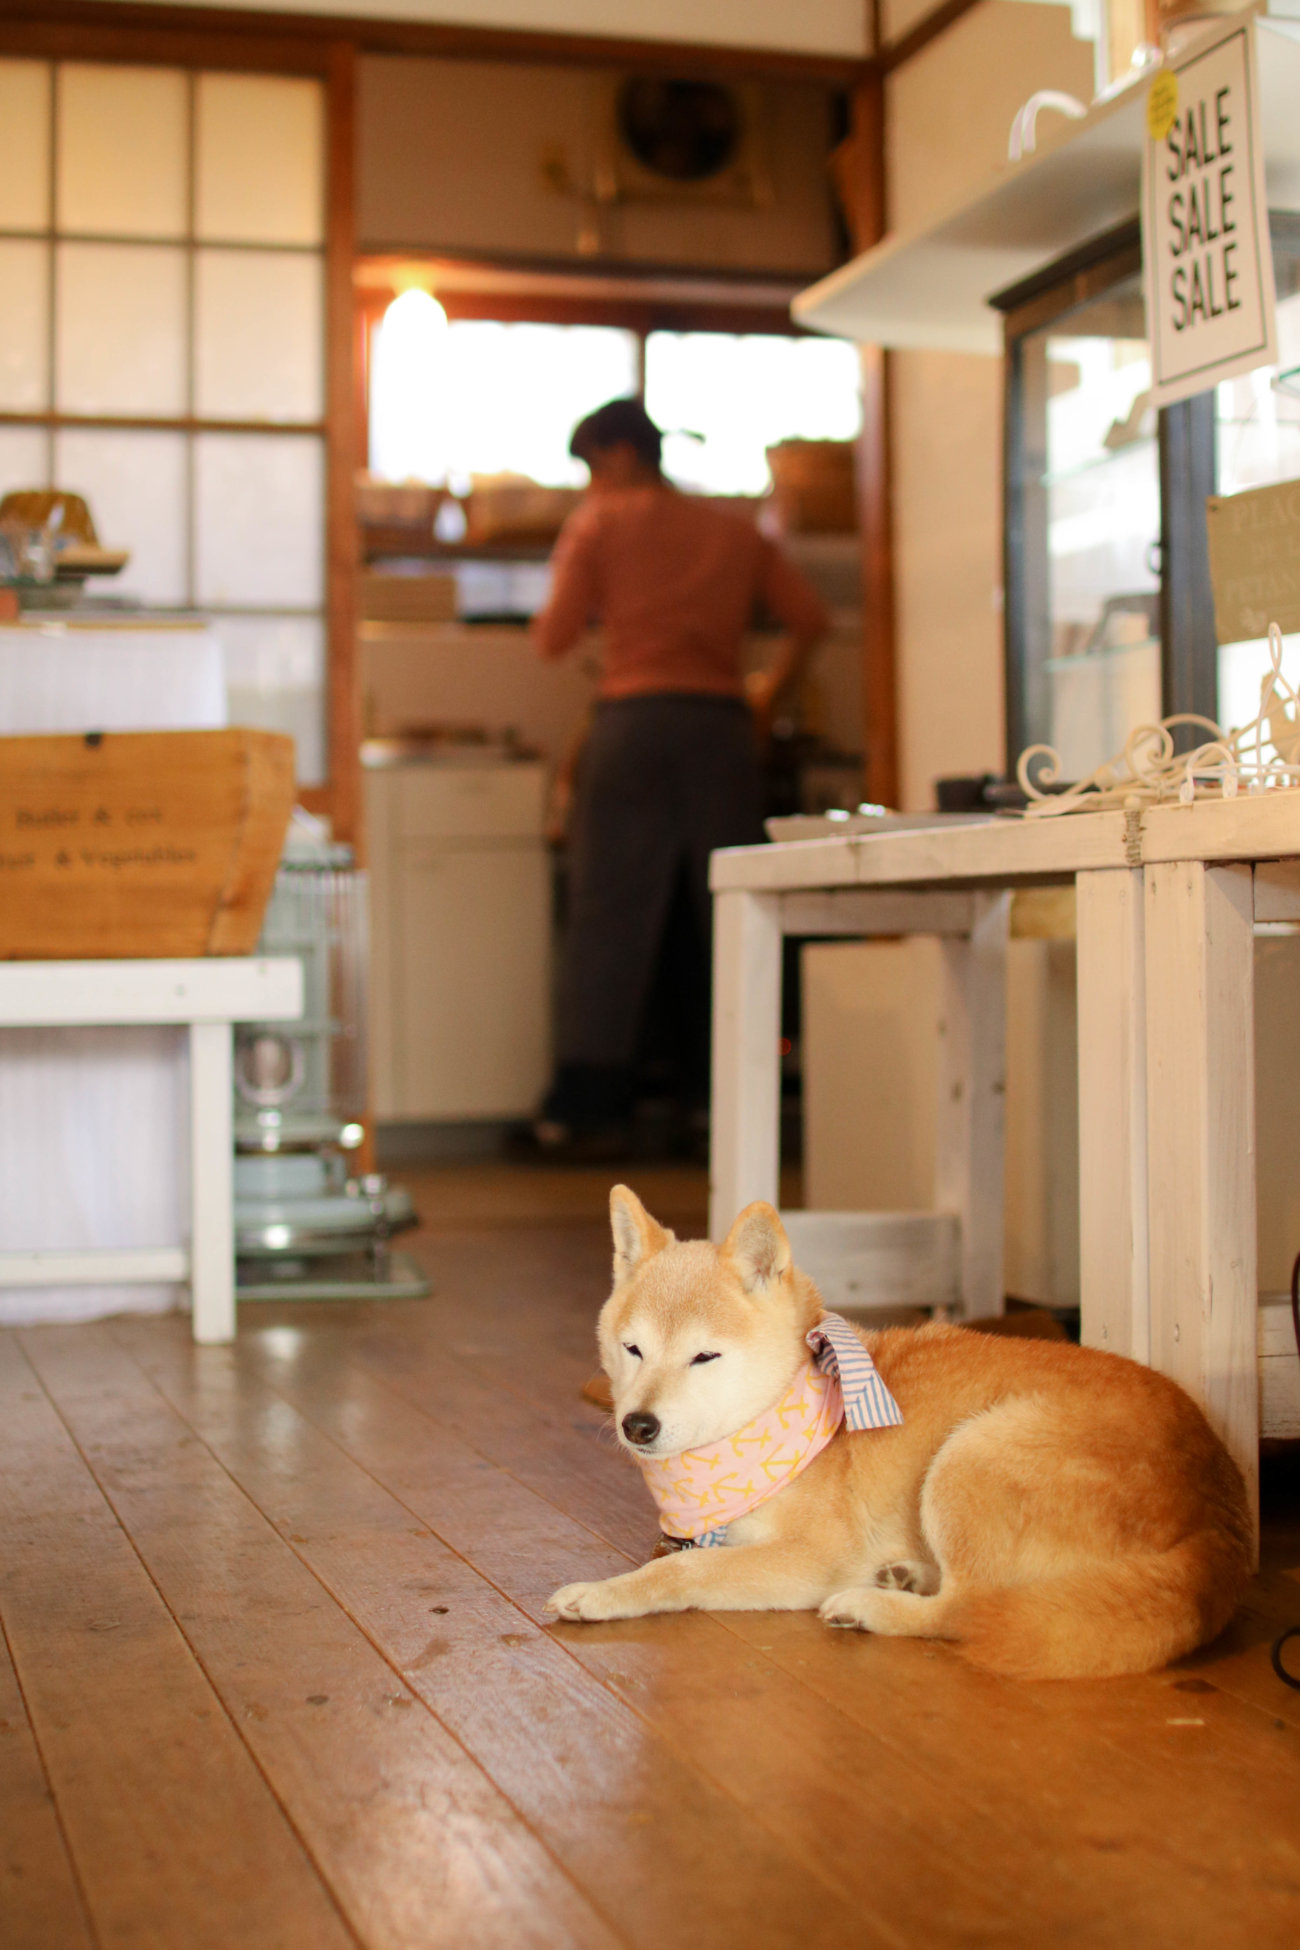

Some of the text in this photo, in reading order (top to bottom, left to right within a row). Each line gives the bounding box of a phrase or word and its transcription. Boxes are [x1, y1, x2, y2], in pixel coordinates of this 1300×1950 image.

[1166, 86, 1233, 181] SALE
[1168, 165, 1237, 256] SALE
[1171, 242, 1241, 331] SALE
